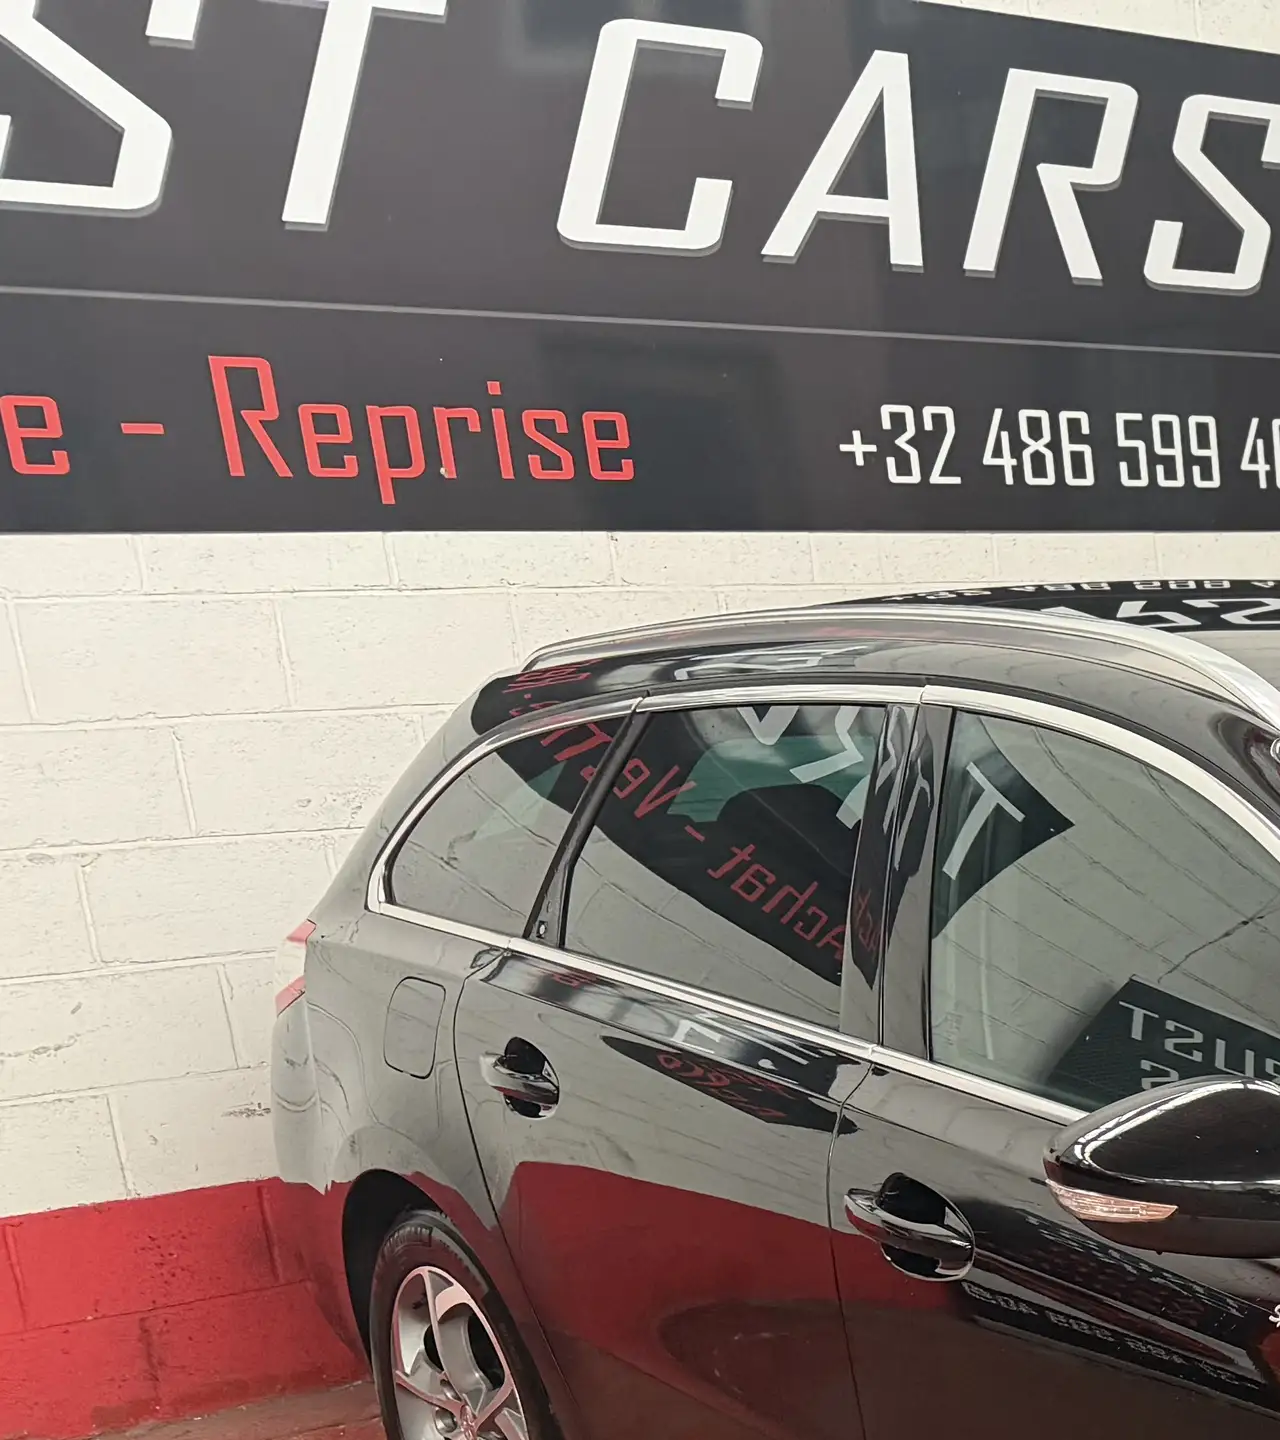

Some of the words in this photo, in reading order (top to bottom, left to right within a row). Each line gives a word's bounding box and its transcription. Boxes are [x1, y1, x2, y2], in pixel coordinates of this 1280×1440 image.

[207, 354, 636, 506] Reprise
[839, 404, 963, 487] +32
[982, 407, 1095, 488] 486
[1115, 411, 1220, 490] 599
